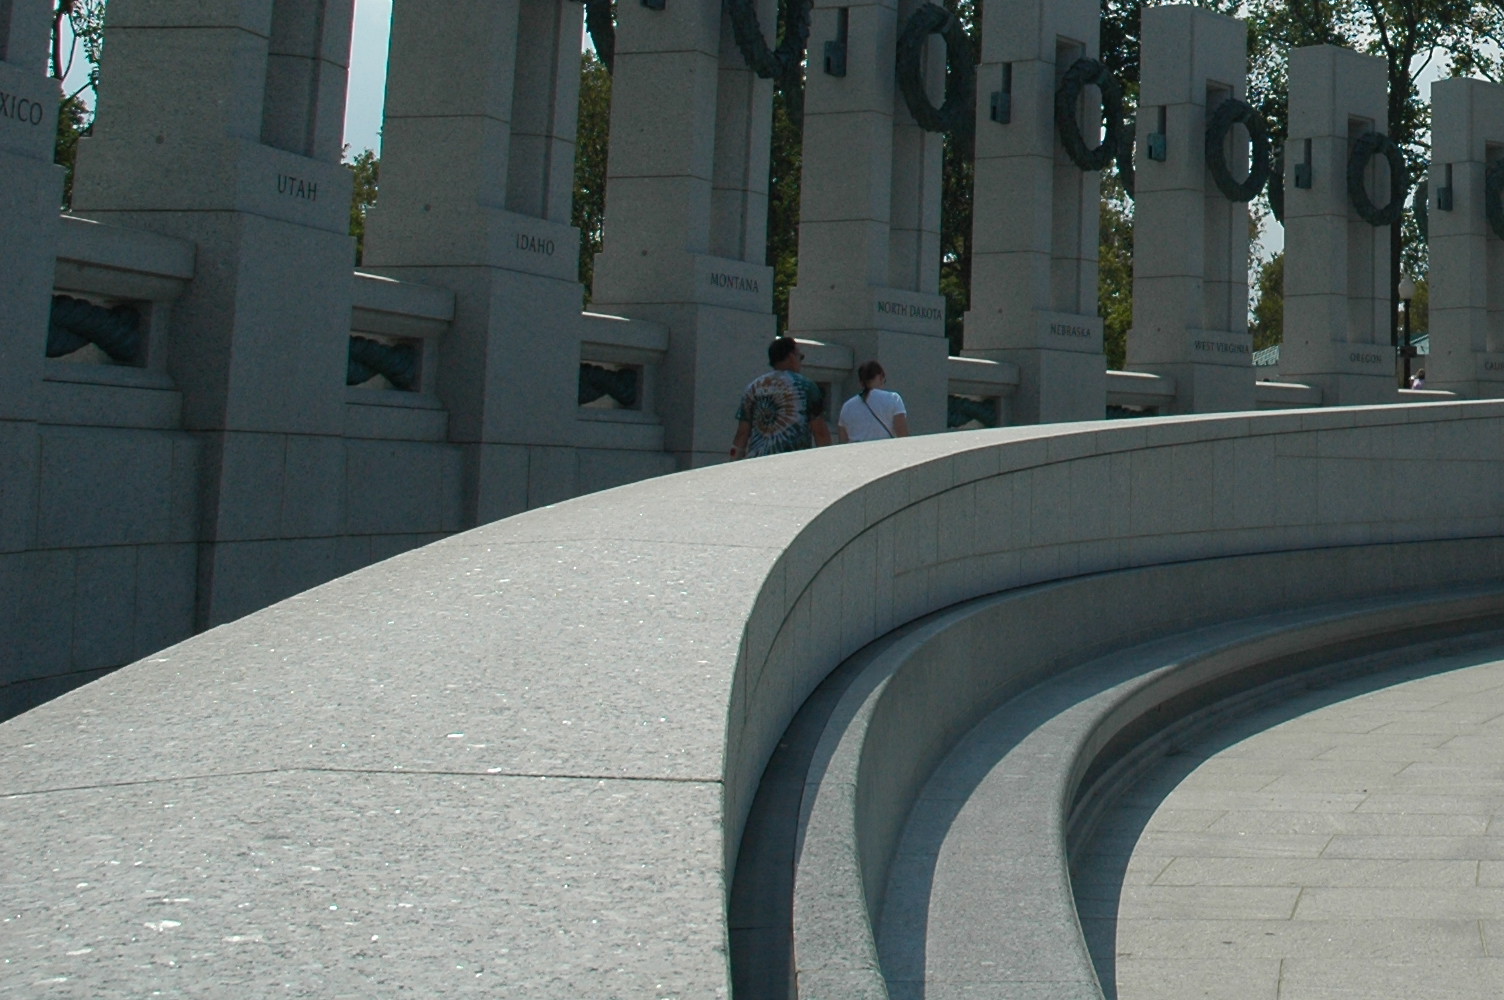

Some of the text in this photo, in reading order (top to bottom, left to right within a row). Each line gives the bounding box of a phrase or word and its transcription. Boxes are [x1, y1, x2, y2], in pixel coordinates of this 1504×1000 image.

[277, 174, 317, 201] UTAH
[516, 233, 555, 256] IDAHO
[711, 272, 760, 293] MONTANA
[878, 301, 943, 321] NORTH DAKOTA
[1050, 322, 1091, 336] NEBRASKA
[1194, 340, 1249, 354] WEST VIRGINIA
[1350, 352, 1382, 363] OREGON
